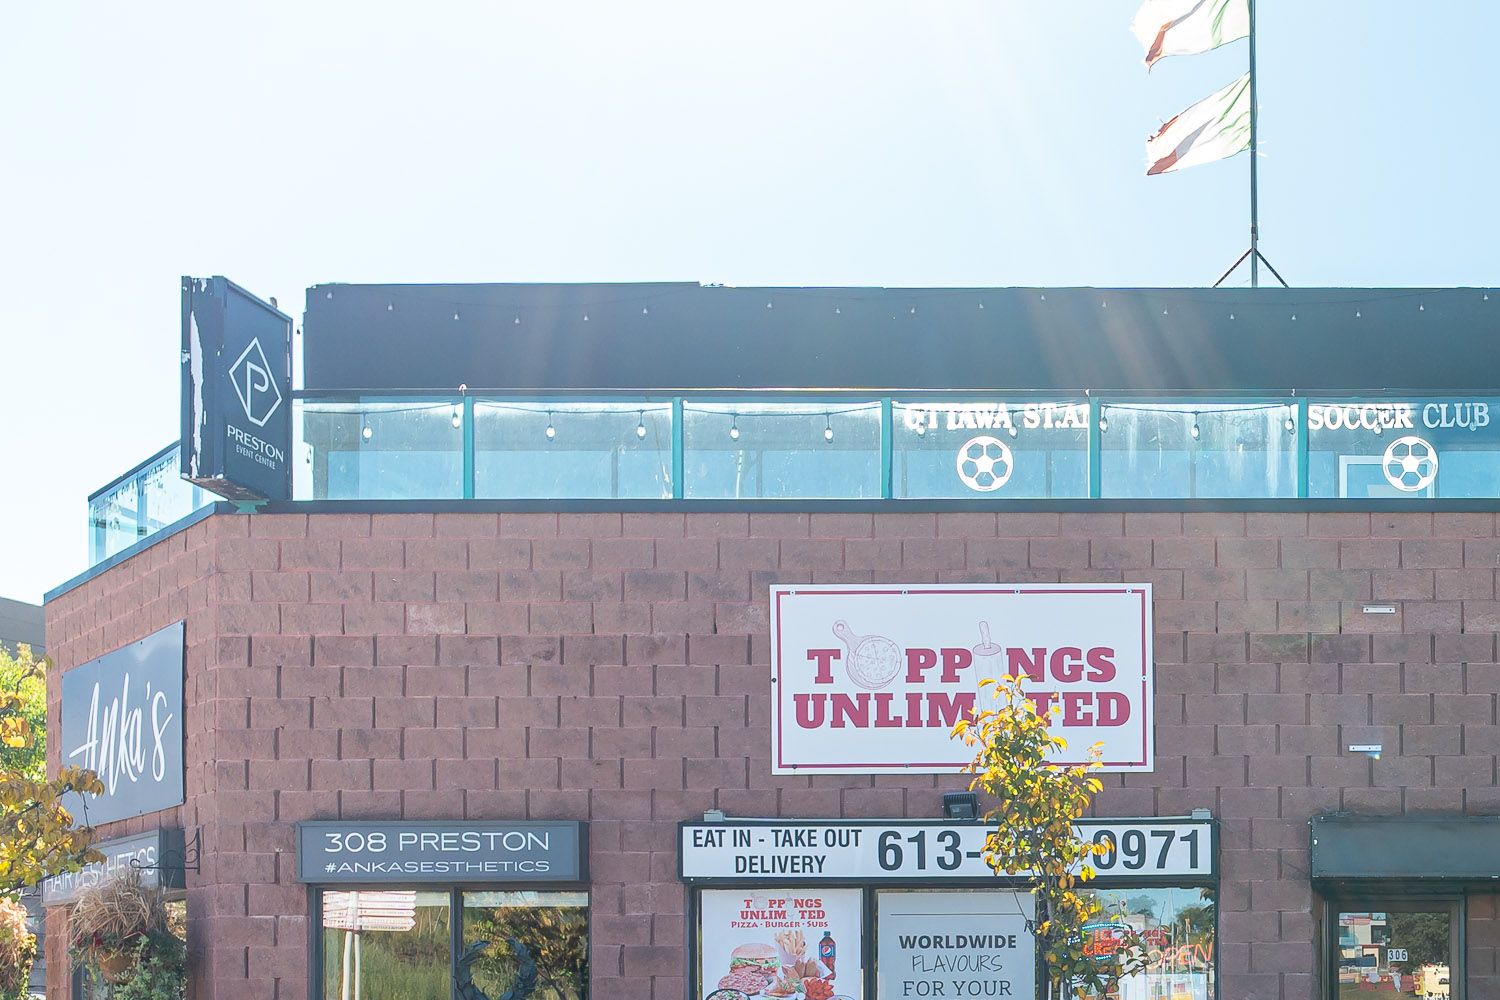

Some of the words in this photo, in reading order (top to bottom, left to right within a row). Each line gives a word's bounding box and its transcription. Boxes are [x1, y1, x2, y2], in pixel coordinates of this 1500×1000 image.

[903, 402, 1013, 430] OTTAWA
[1307, 403, 1414, 430] SOCCER
[1422, 402, 1491, 429] CLUB
[227, 424, 284, 463] PRESTON
[236, 444, 254, 459] EVENT
[254, 453, 276, 470] CENTRE
[793, 691, 1131, 729] UNLIMTED
[69, 671, 174, 800] Anka's
[324, 832, 387, 853] 308
[399, 831, 549, 852] PRESTON
[693, 830, 728, 848] EAT
[732, 830, 752, 848] IN
[771, 829, 820, 848] TAKE
[824, 829, 863, 848] OUT
[877, 828, 1200, 871] 613--0971
[324, 860, 550, 873] #ANKASESTHETICS
[734, 856, 827, 874] DELIVERY
[898, 935, 1017, 949] WORLDWIDE
[912, 954, 1003, 973] FLAVOURS
[1388, 950, 1408, 960] 306
[903, 980, 946, 996] FOR
[952, 980, 1013, 996] YOUR
